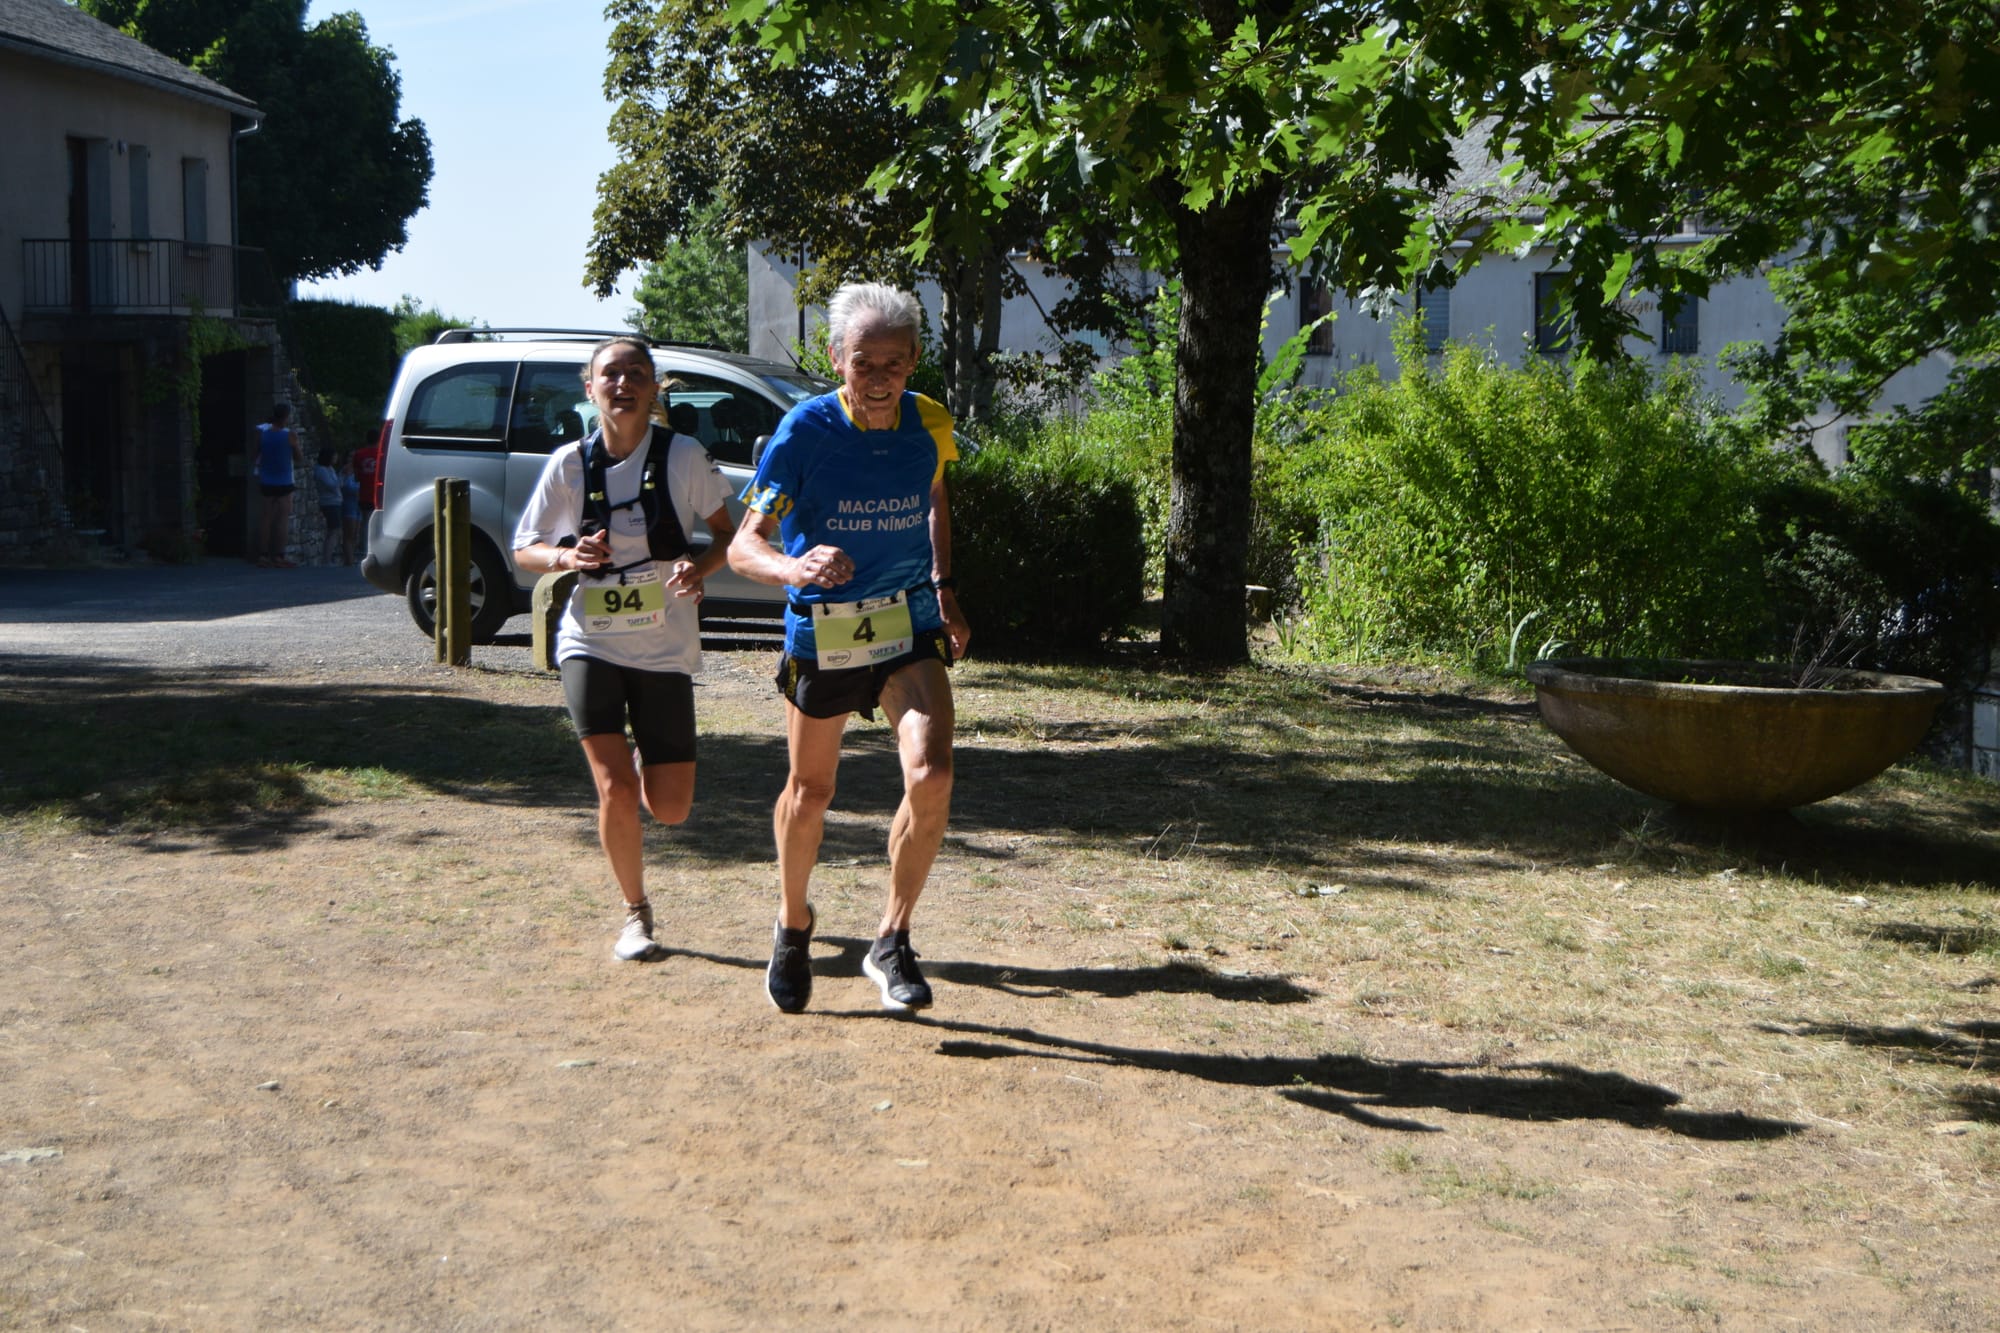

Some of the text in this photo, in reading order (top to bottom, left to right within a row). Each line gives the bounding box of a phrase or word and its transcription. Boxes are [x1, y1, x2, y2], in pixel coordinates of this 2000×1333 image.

[838, 494, 919, 513] MACADAM
[826, 511, 923, 531] CLUB NÎMOIS
[604, 589, 643, 613] 94
[853, 617, 876, 642] 4
